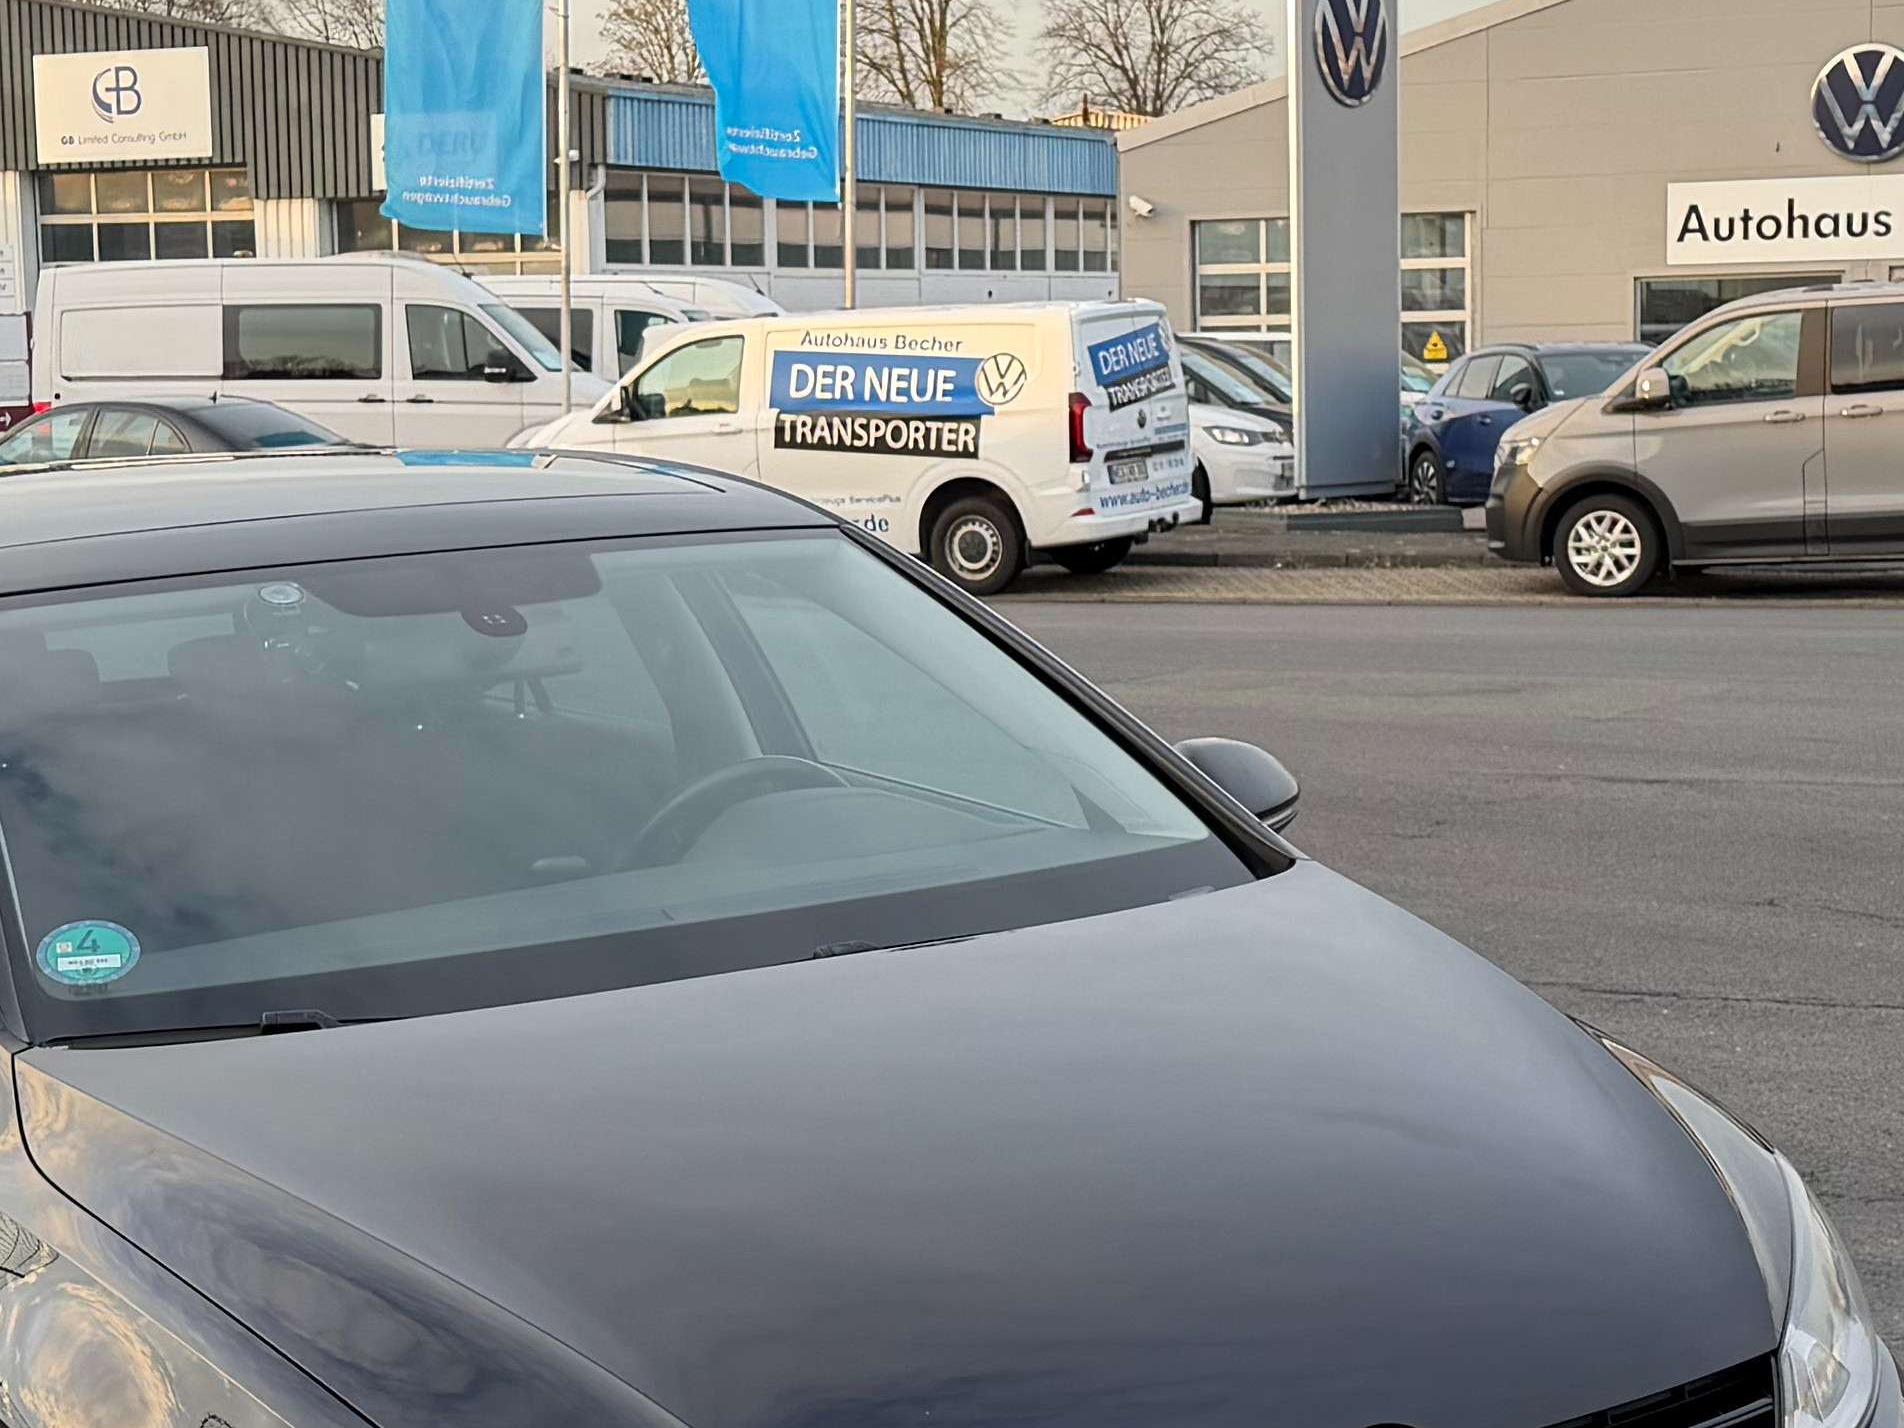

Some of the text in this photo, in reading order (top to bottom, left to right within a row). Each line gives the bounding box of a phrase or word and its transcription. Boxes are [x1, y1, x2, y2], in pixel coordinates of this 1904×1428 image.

[1676, 198, 1892, 244] Autohaus
[800, 330, 963, 352] Autohaus Becher
[1098, 333, 1160, 375] DER NEUE
[789, 363, 957, 403] DER NEUE
[780, 415, 976, 452] TRANSPORTER
